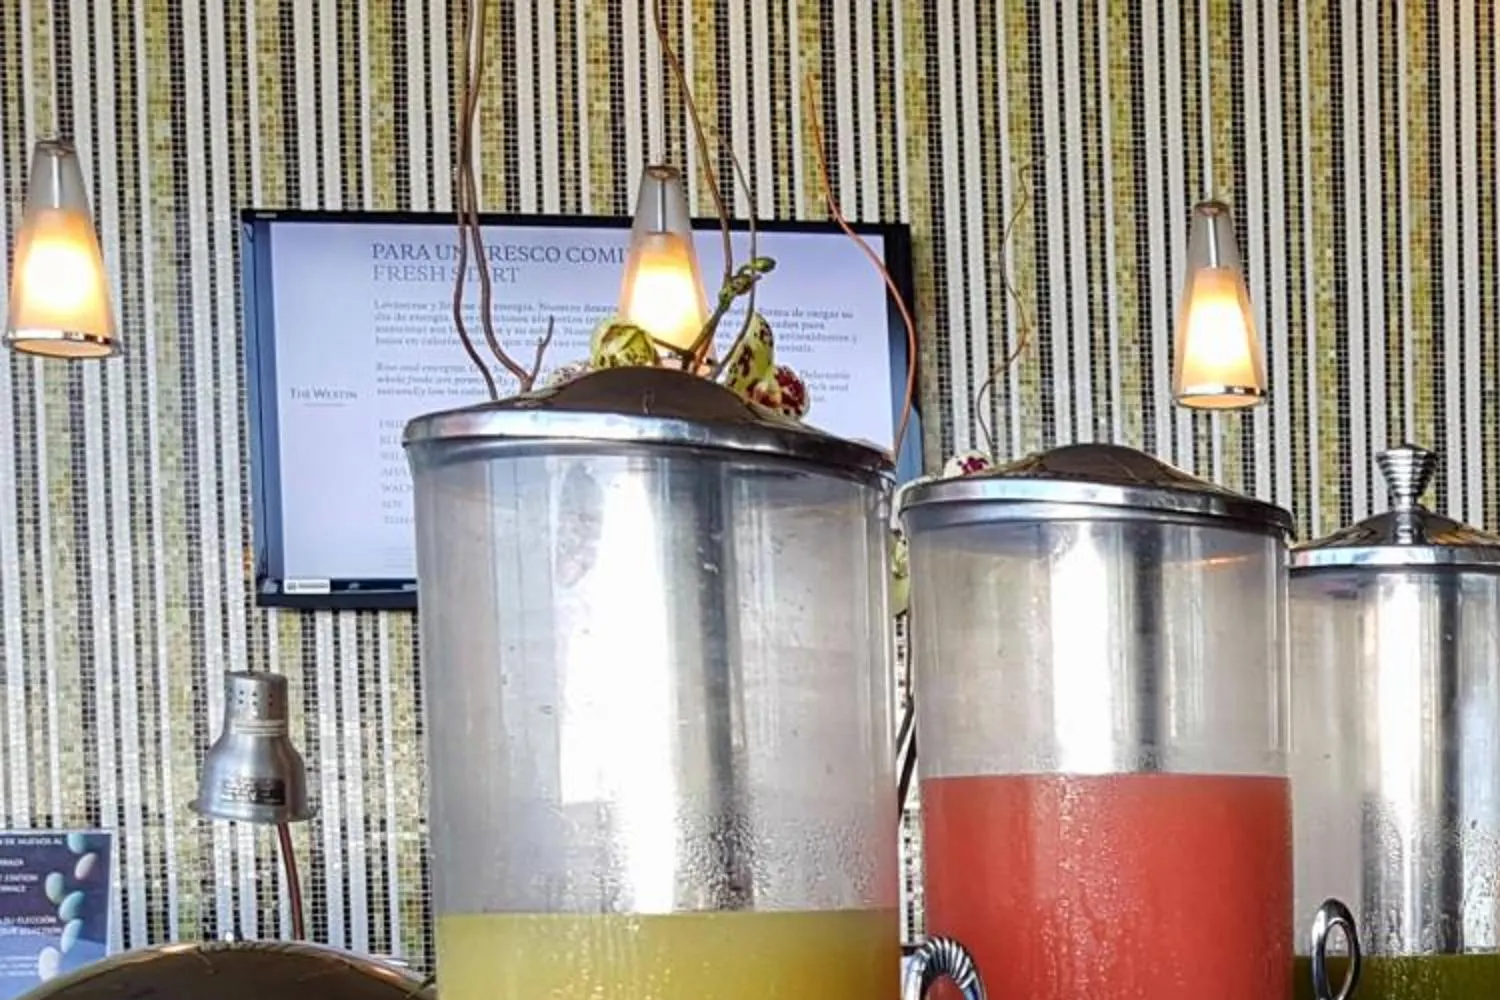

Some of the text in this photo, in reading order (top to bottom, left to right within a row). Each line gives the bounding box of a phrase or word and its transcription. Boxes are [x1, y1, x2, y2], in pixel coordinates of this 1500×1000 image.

[371, 243, 431, 261] PARA
[482, 244, 560, 262] RESCO
[565, 246, 629, 265] COMI
[373, 264, 520, 283] FRESH STRT
